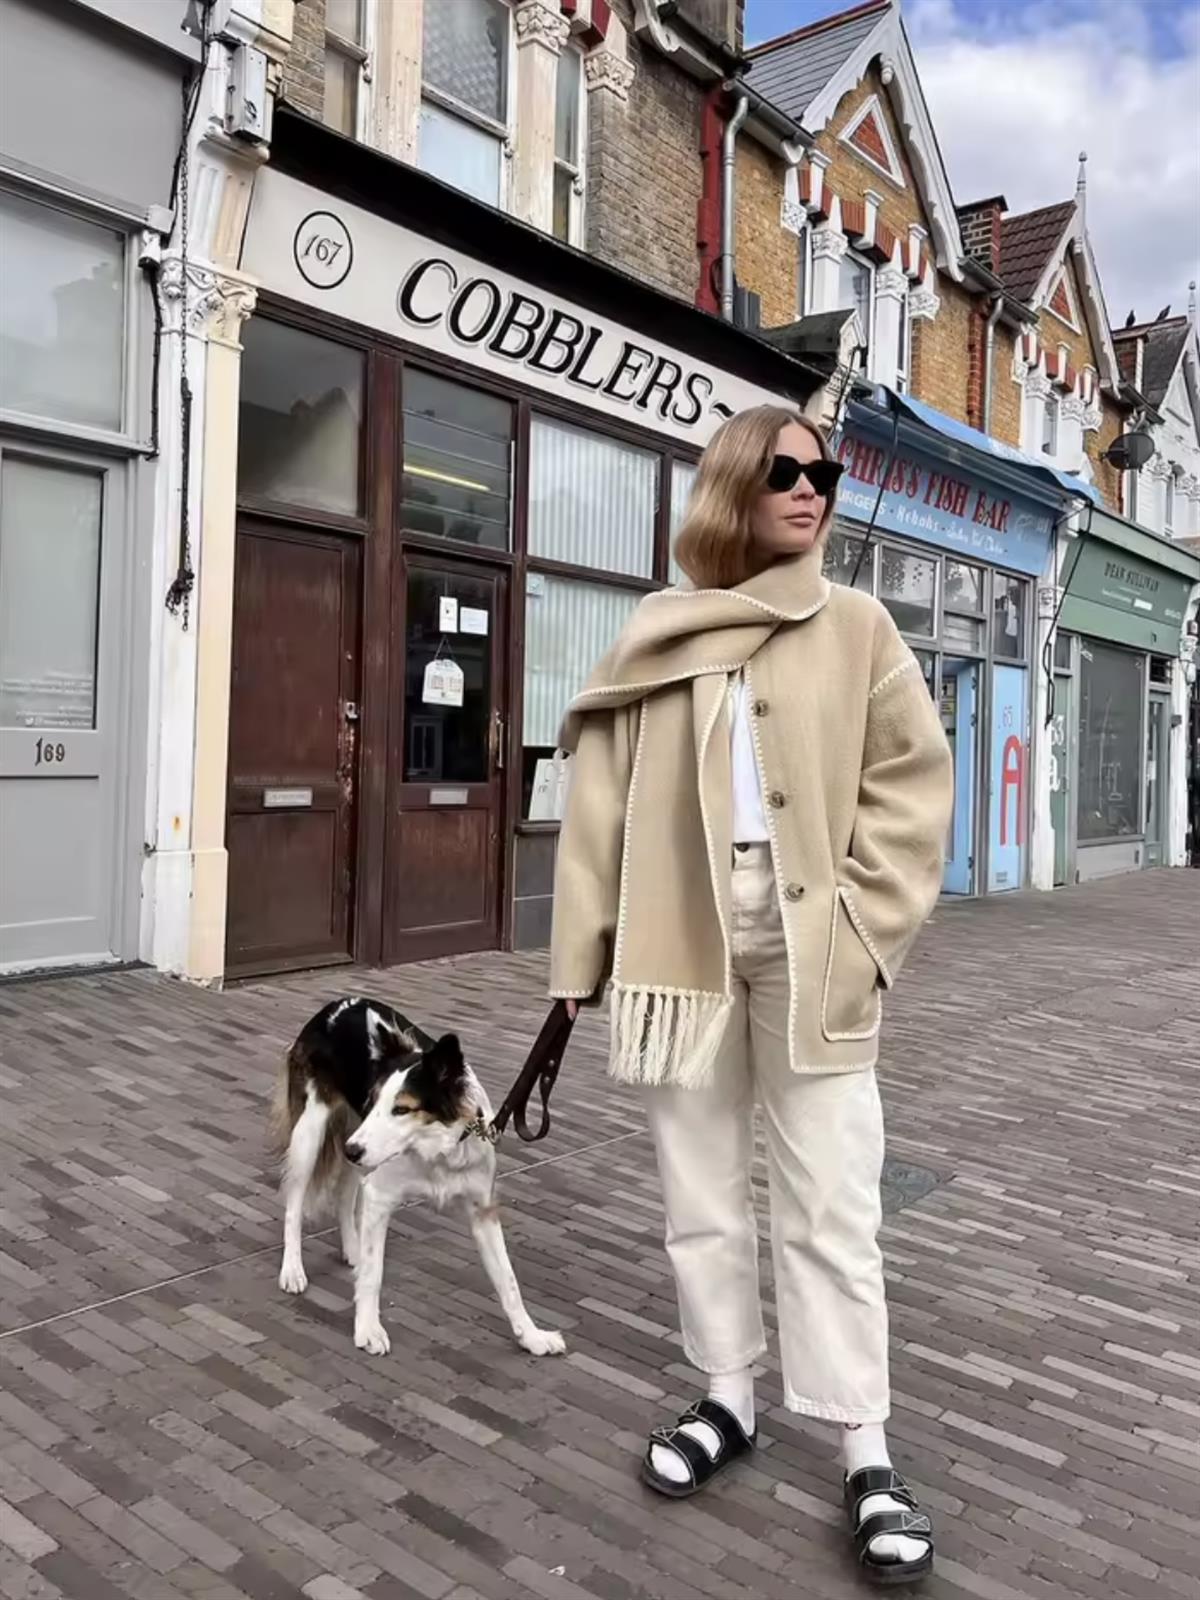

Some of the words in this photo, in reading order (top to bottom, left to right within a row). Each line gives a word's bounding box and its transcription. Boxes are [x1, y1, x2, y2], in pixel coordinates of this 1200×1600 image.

[304, 234, 343, 267] 167
[398, 257, 713, 425] COBBLERS
[923, 471, 970, 517] FISH
[972, 490, 1012, 534] BAR
[35, 736, 65, 766] 169
